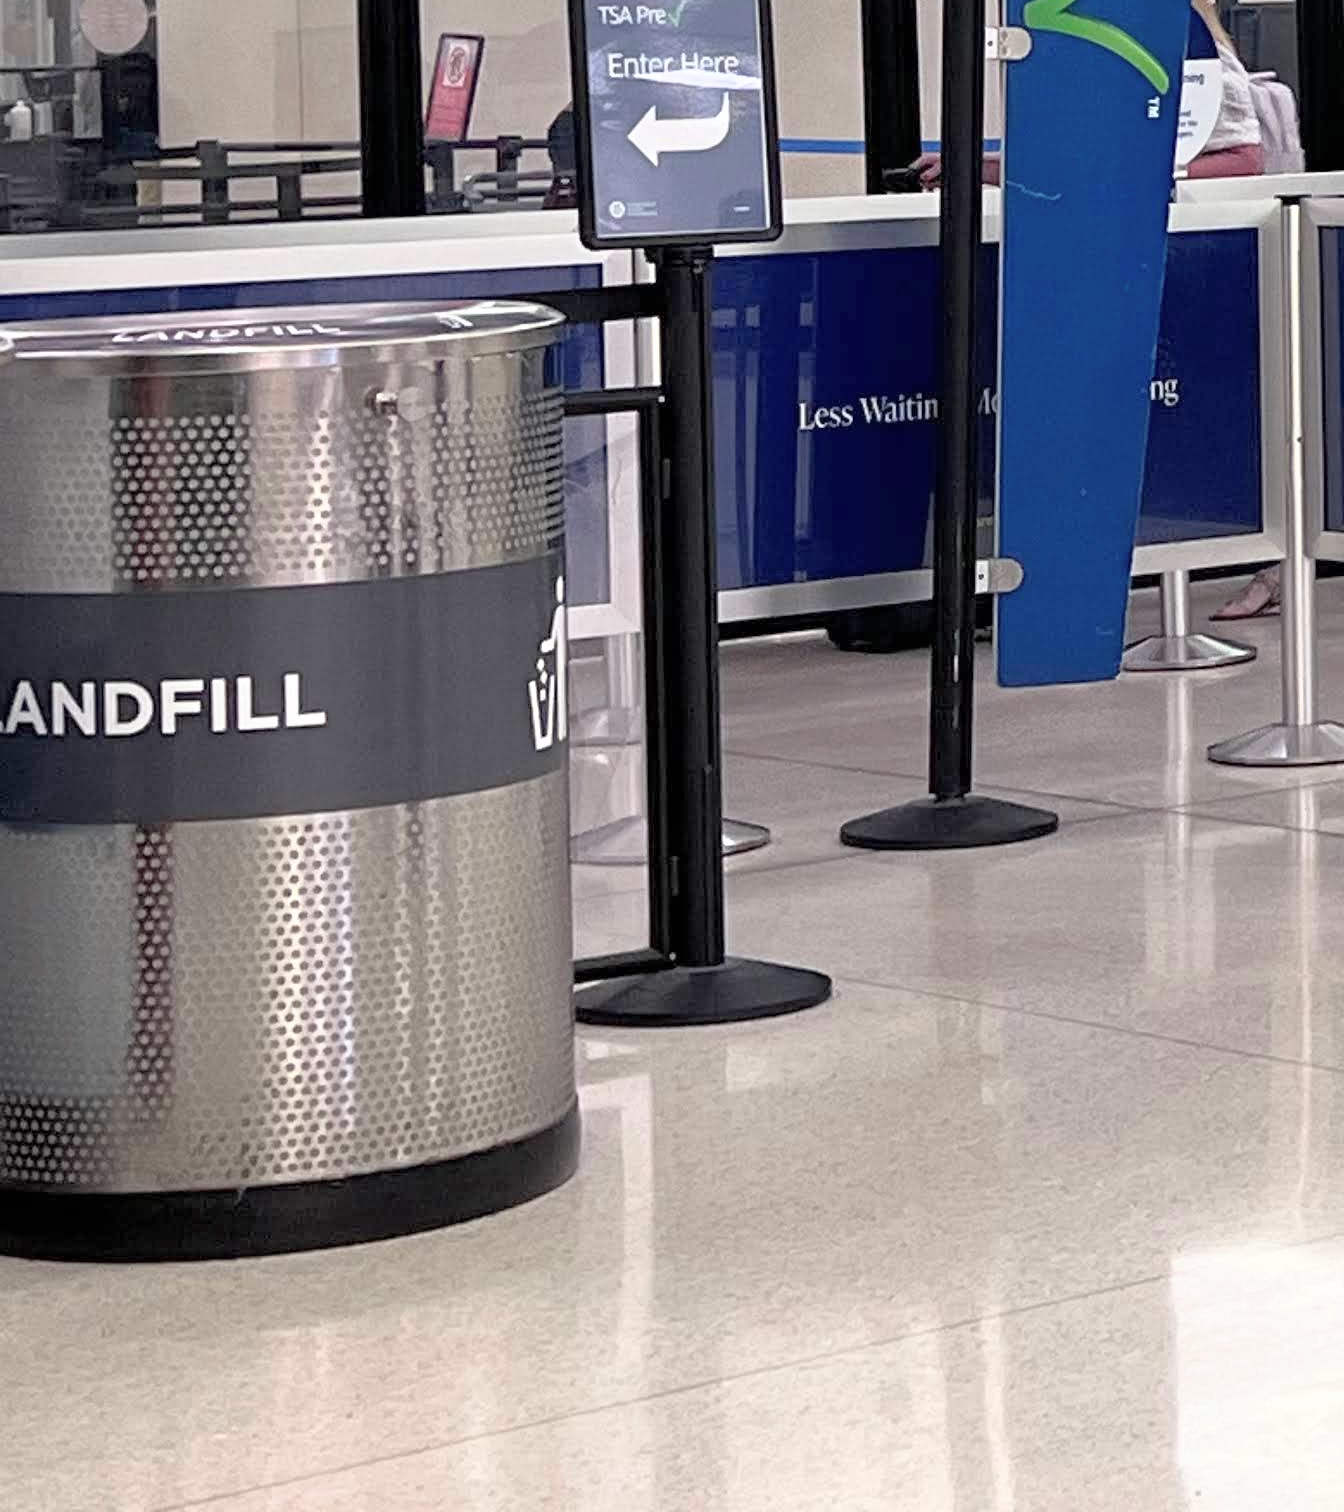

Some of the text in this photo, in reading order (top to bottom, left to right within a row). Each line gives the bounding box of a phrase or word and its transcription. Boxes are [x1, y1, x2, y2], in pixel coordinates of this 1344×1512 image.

[598, 5, 667, 25] TSA Pre
[608, 52, 740, 78] Enter Here
[111, 322, 343, 343] LANDFILL
[799, 400, 854, 432] Less
[860, 392, 940, 424] Waitin
[0, 673, 327, 737] ANDFILL
